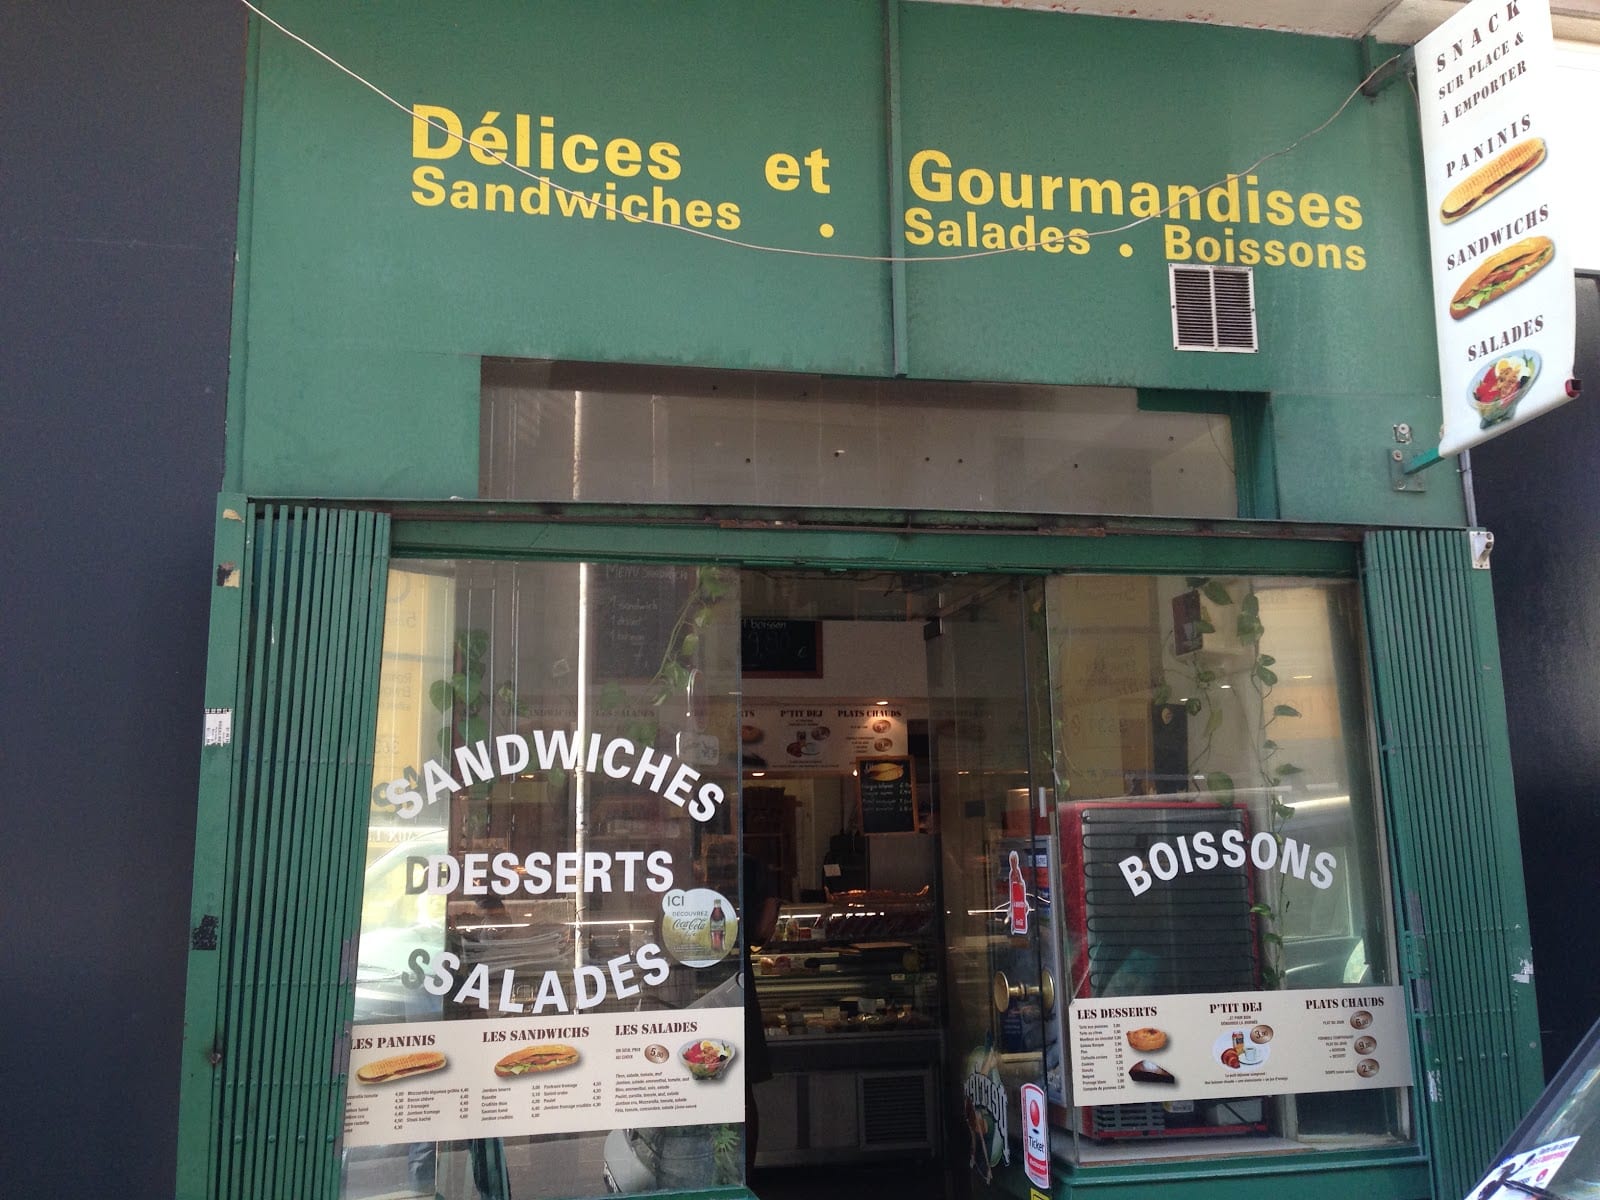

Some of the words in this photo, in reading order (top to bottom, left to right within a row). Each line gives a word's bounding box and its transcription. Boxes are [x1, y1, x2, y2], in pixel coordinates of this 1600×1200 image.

[1436, 0, 1521, 73] SNACK
[1438, 74, 1465, 100] SUR
[1468, 41, 1510, 80] PLACE
[1514, 31, 1525, 46] &
[1441, 110, 1450, 127] À
[1454, 60, 1527, 118] EMPORTER
[412, 103, 682, 181] Délices
[764, 147, 831, 194] et
[908, 149, 1364, 231] Gourmandises
[1446, 113, 1531, 179] PANINIS
[411, 166, 741, 231] Sandwiches
[904, 207, 1091, 256] Salades
[1164, 225, 1367, 272] Boissons
[1447, 204, 1550, 271] SANDWICHS
[1467, 314, 1544, 362] SALADES
[386, 730, 725, 824] SANDWICHES
[426, 850, 674, 895] DESSERTS
[1118, 829, 1337, 897] BOISSONS
[668, 896, 685, 907] ICI
[423, 943, 670, 1015] SALADES
[1306, 998, 1339, 1010] PLATS
[1341, 996, 1385, 1009] CHAUDS
[482, 1031, 506, 1043] LES
[510, 1026, 590, 1042] SANDWICHS
[616, 1024, 639, 1036] LES
[642, 1022, 698, 1035] SALADES
[1078, 1009, 1097, 1020] LES
[1100, 1006, 1158, 1019] DESSERTS
[1210, 1003, 1239, 1014] P'TIT
[1242, 1002, 1263, 1013] DEJ
[351, 1038, 373, 1050] LES
[377, 1034, 436, 1050] PANINIS
[1028, 1136, 1045, 1153] Ticket
